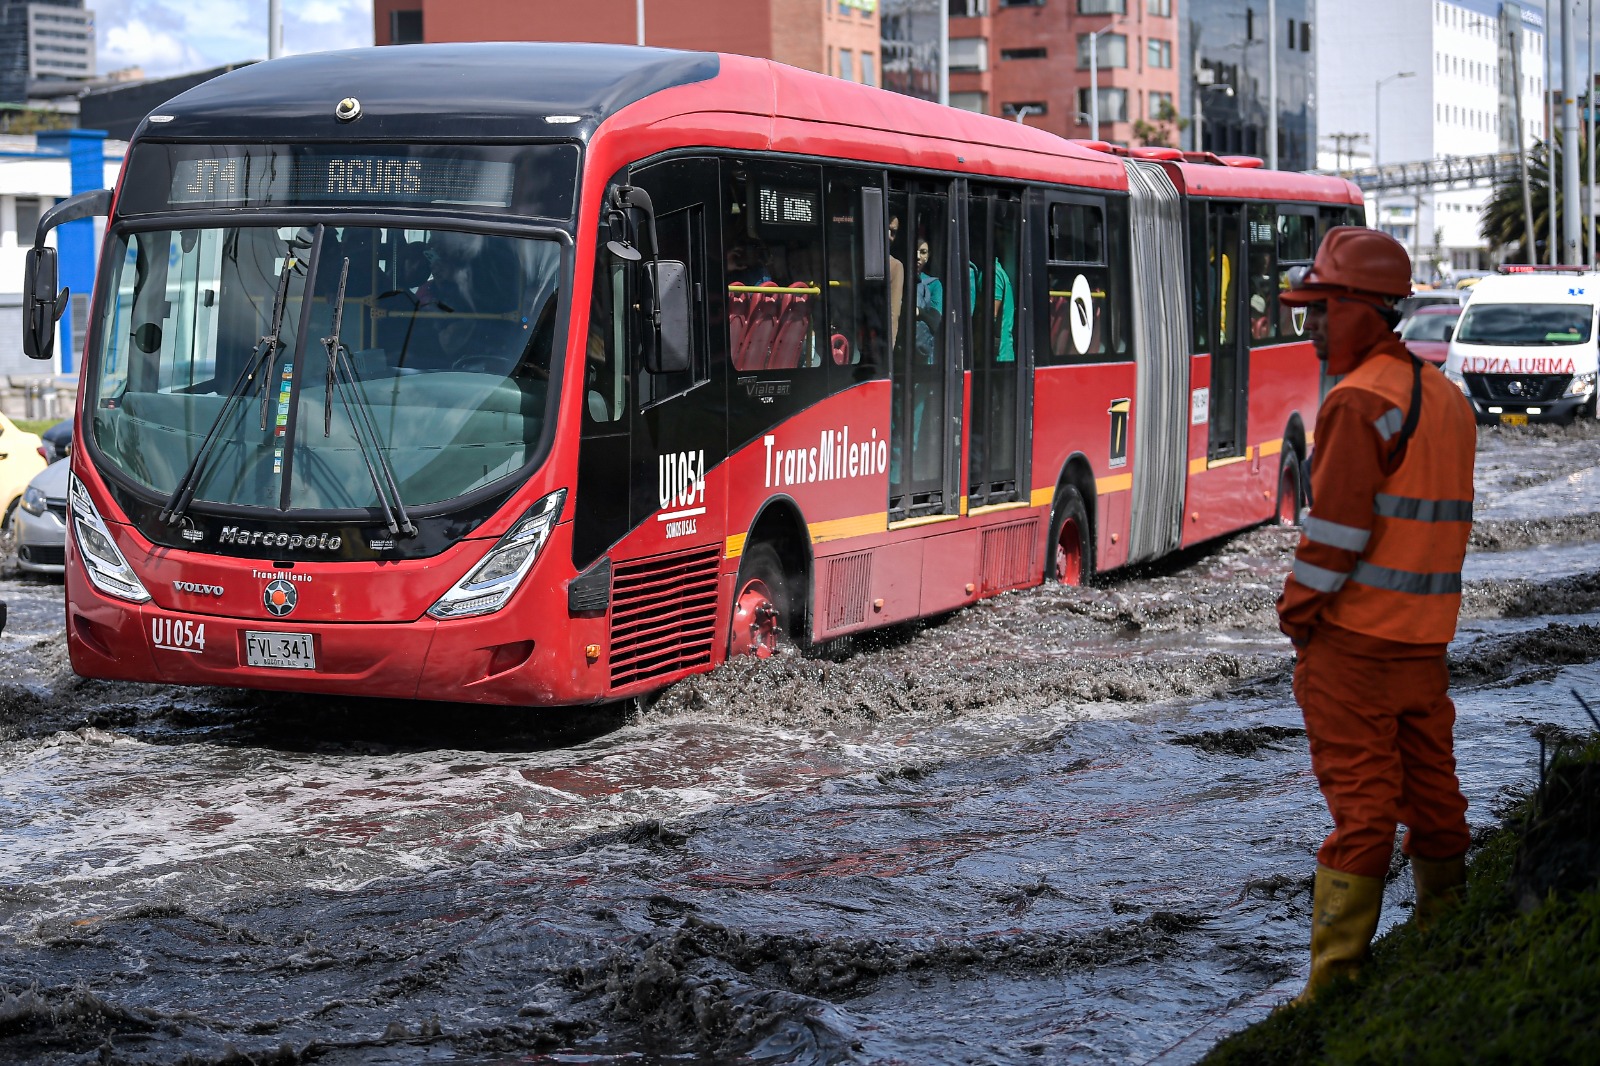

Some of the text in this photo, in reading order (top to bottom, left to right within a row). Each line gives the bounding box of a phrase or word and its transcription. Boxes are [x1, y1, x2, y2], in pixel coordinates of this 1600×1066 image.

[187, 159, 422, 194] J74 AGUAS
[746, 383, 775, 395] Viale
[764, 425, 887, 488] TransMilenio
[659, 449, 706, 510] U1054
[219, 525, 342, 550] Marcopolo
[172, 580, 225, 596] VOLVO
[252, 569, 313, 583] TransMilenio
[152, 617, 206, 650] U1054
